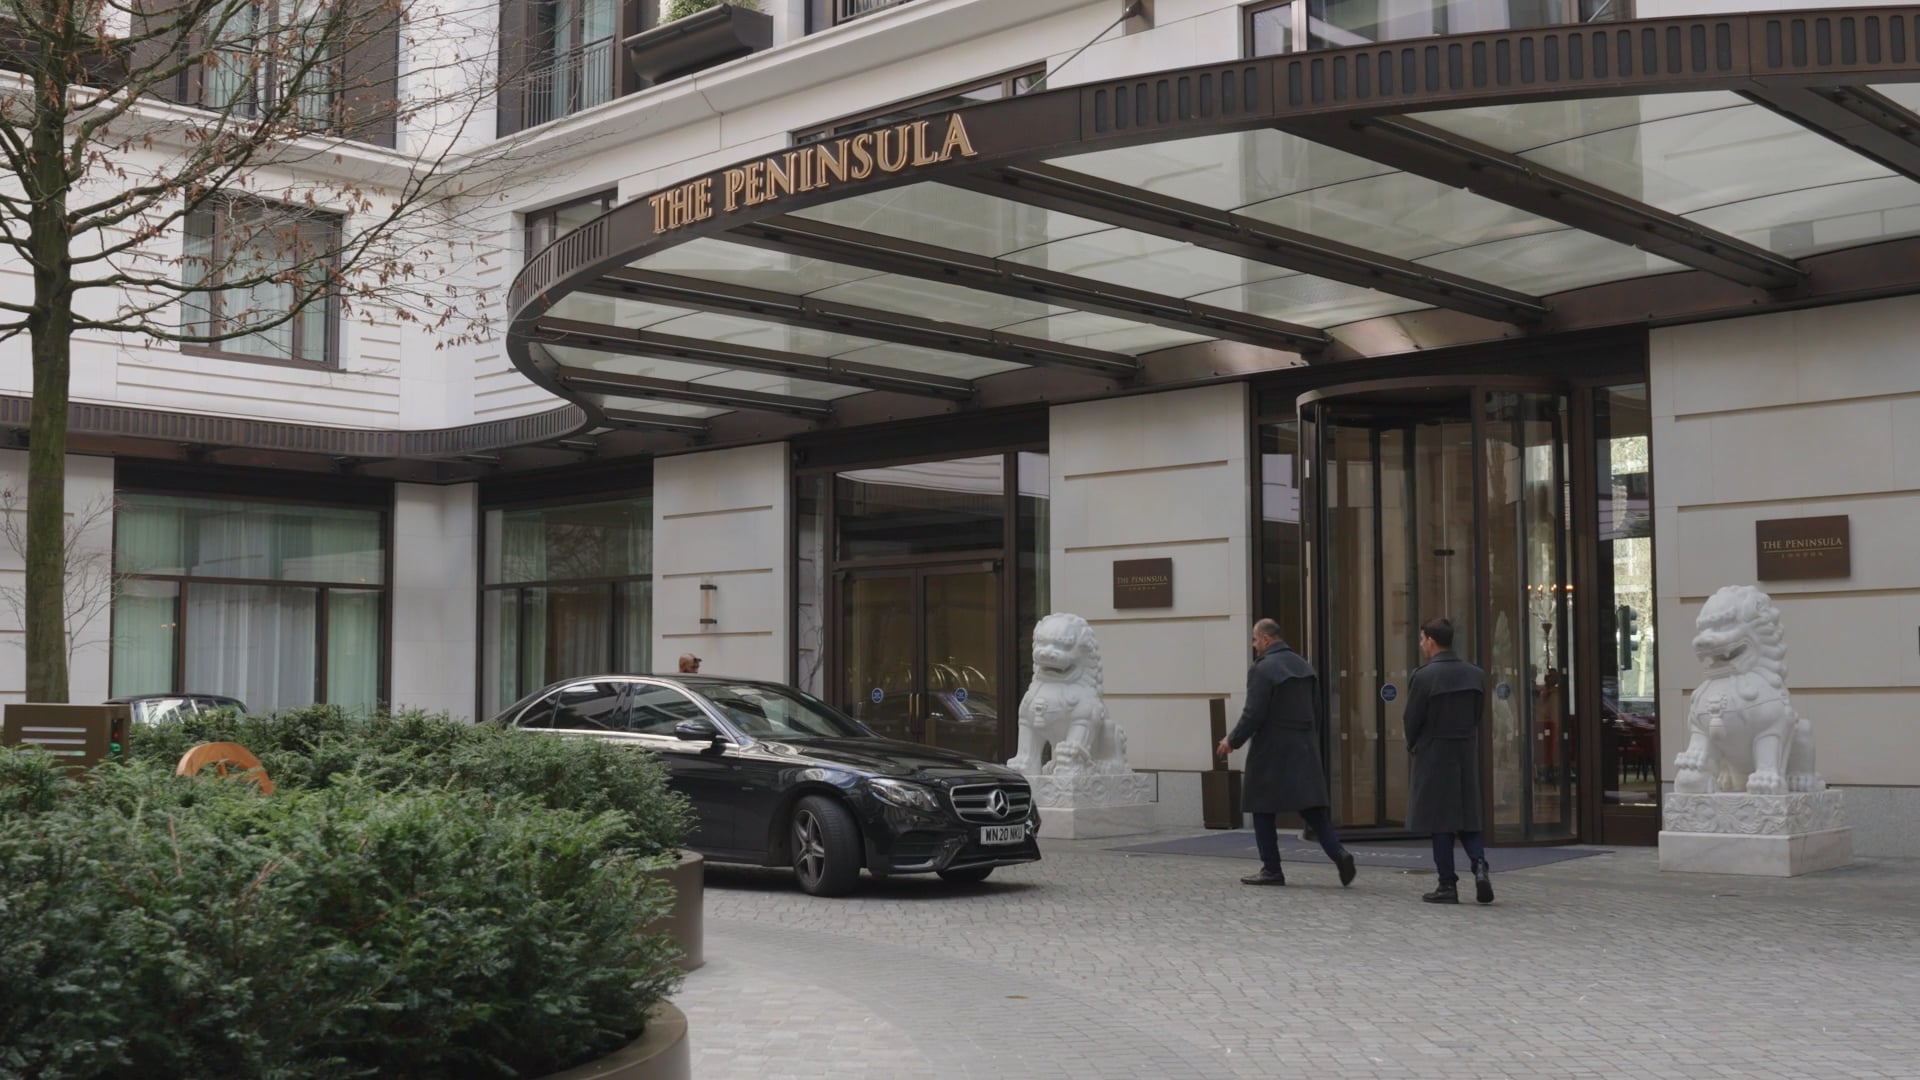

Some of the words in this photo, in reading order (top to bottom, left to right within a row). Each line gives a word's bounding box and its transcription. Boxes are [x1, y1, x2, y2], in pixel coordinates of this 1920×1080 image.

[648, 177, 713, 234] THE
[723, 113, 977, 211] PENINSULA
[1762, 540, 1782, 550] THE
[1785, 537, 1843, 549] PENINSULA
